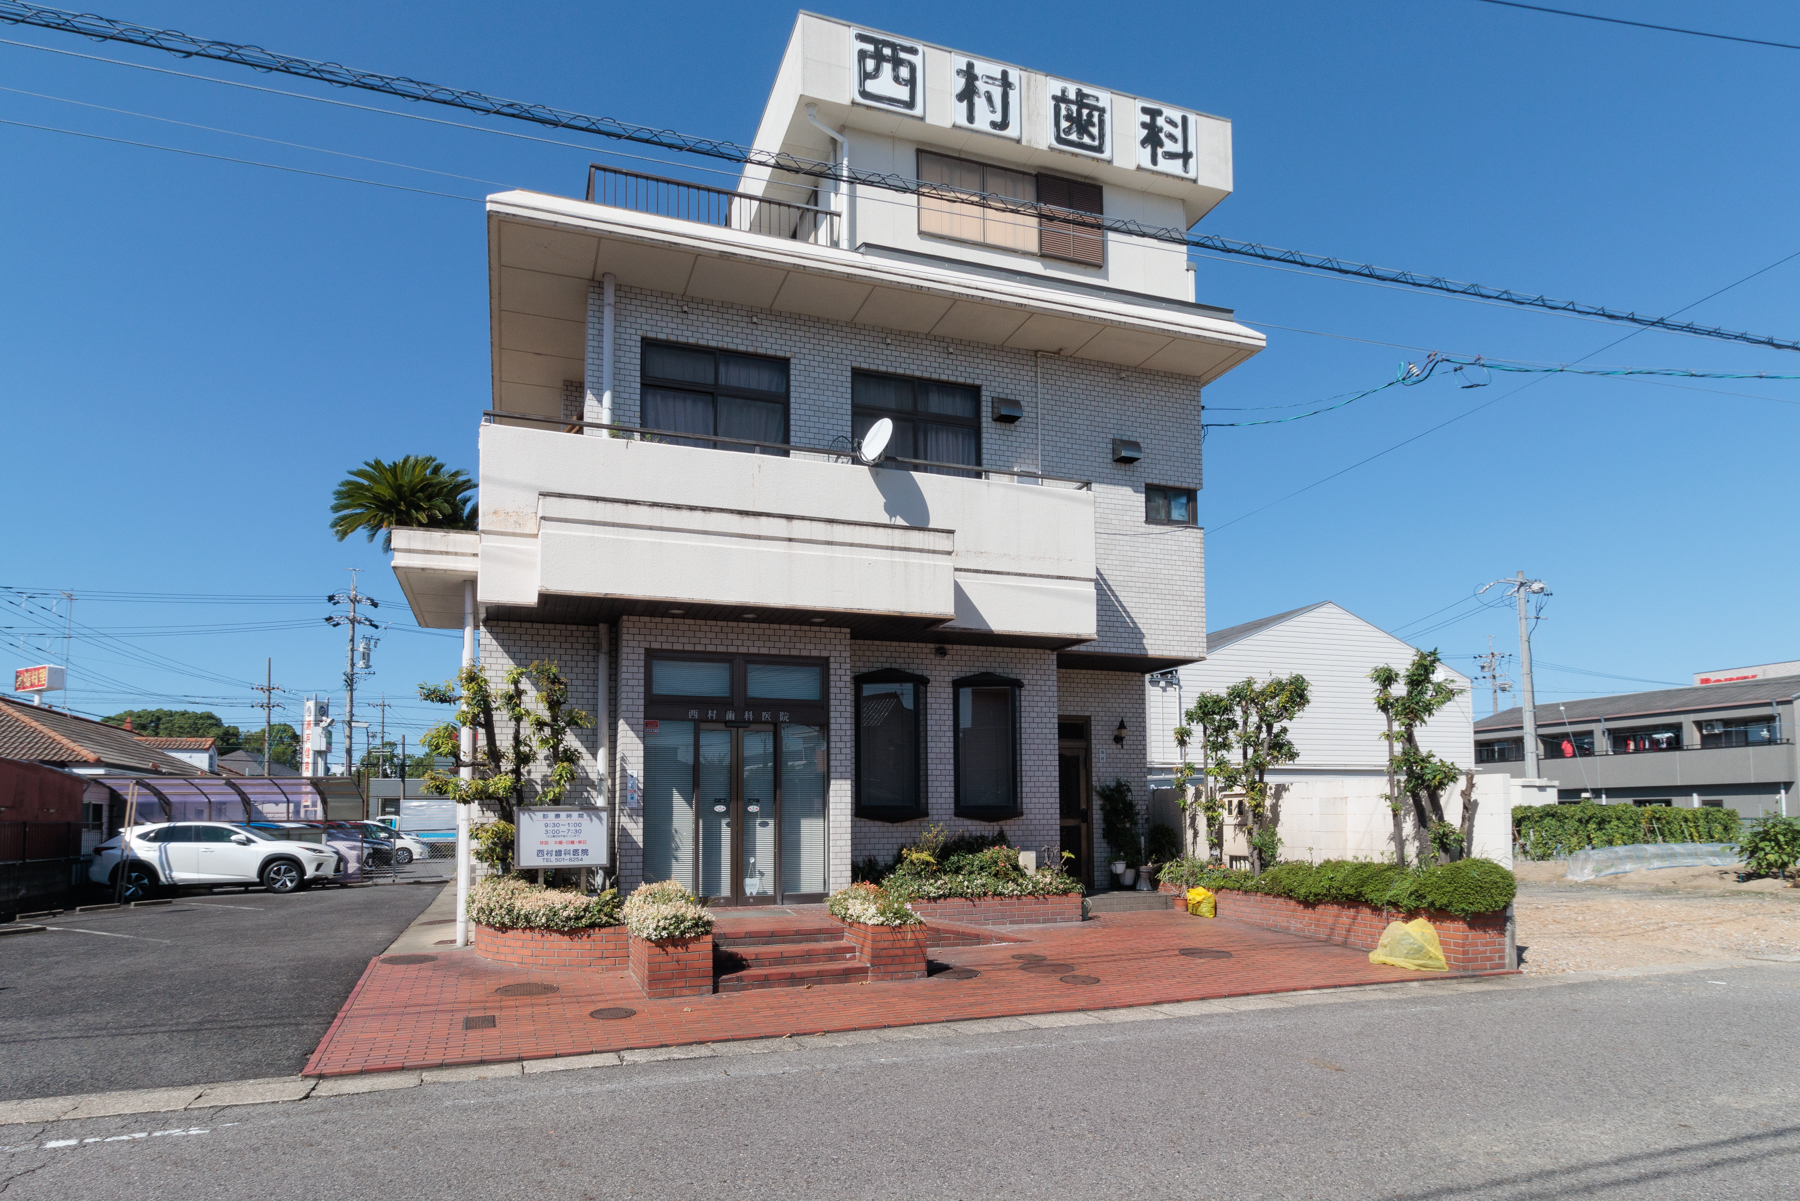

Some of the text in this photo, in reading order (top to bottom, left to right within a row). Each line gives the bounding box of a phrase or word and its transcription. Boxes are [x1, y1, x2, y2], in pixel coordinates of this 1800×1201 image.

[855, 32, 1194, 174] 西村歯科
[688, 709, 790, 722] 西村歯科医院
[536, 849, 589, 857] 西村歯科医院
